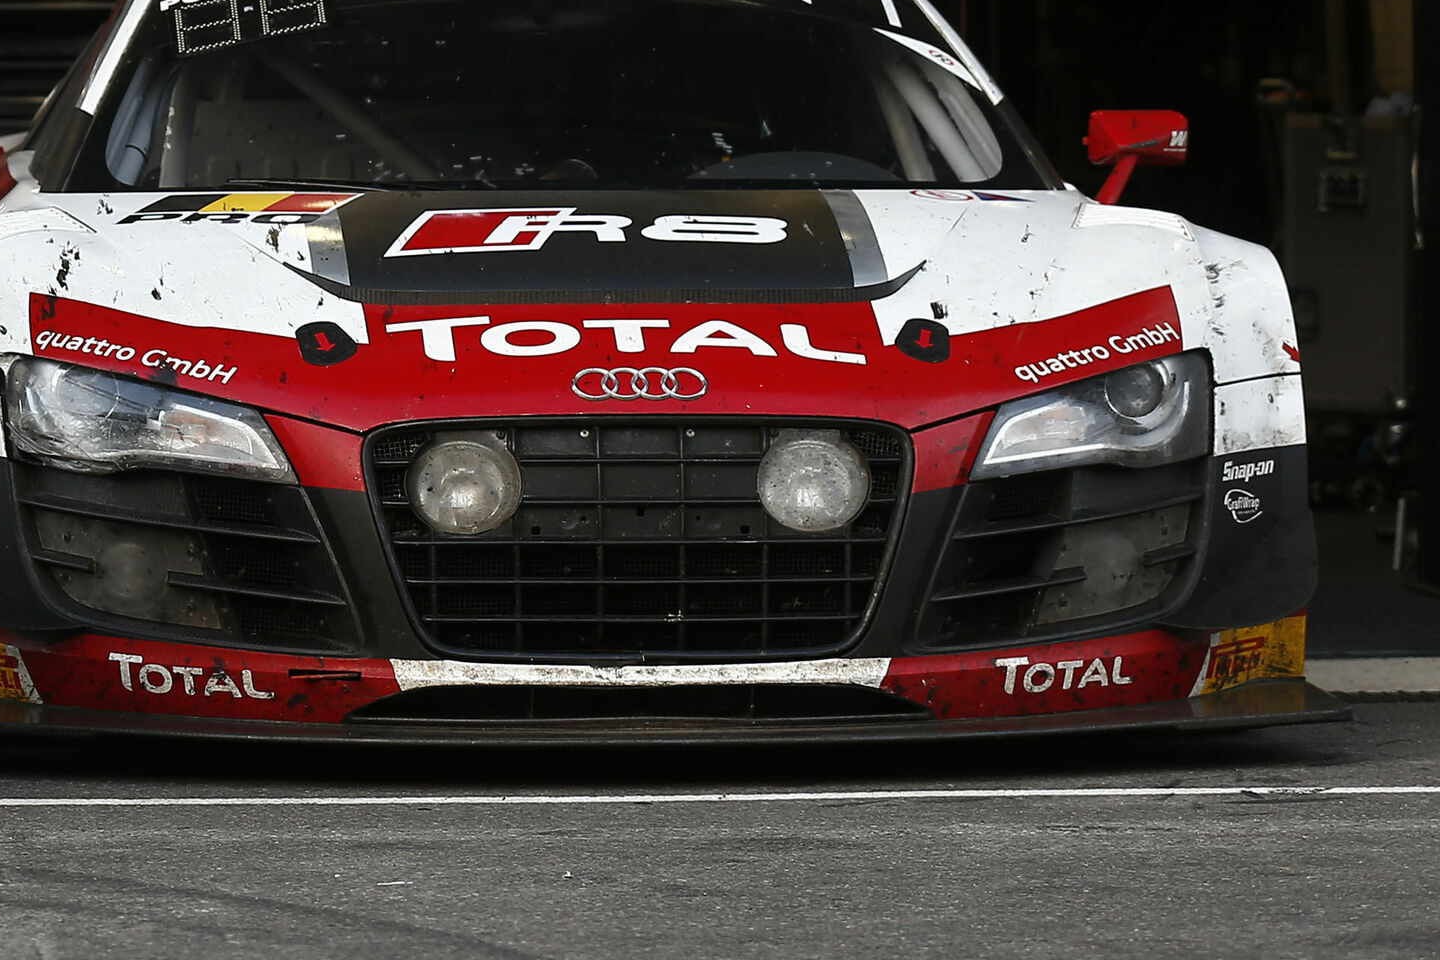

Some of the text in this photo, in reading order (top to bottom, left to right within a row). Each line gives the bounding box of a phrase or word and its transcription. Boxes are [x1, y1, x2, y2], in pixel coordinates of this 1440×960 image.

[115, 212, 323, 225] PRO
[478, 207, 788, 245] R8
[34, 329, 239, 385] quattro GmbH
[385, 315, 867, 366] TOTAL
[1013, 321, 1181, 384] quattro GmbH
[1222, 459, 1275, 483] Snap-on
[108, 652, 275, 701] TOTAL
[995, 656, 1133, 696] TOTAL
